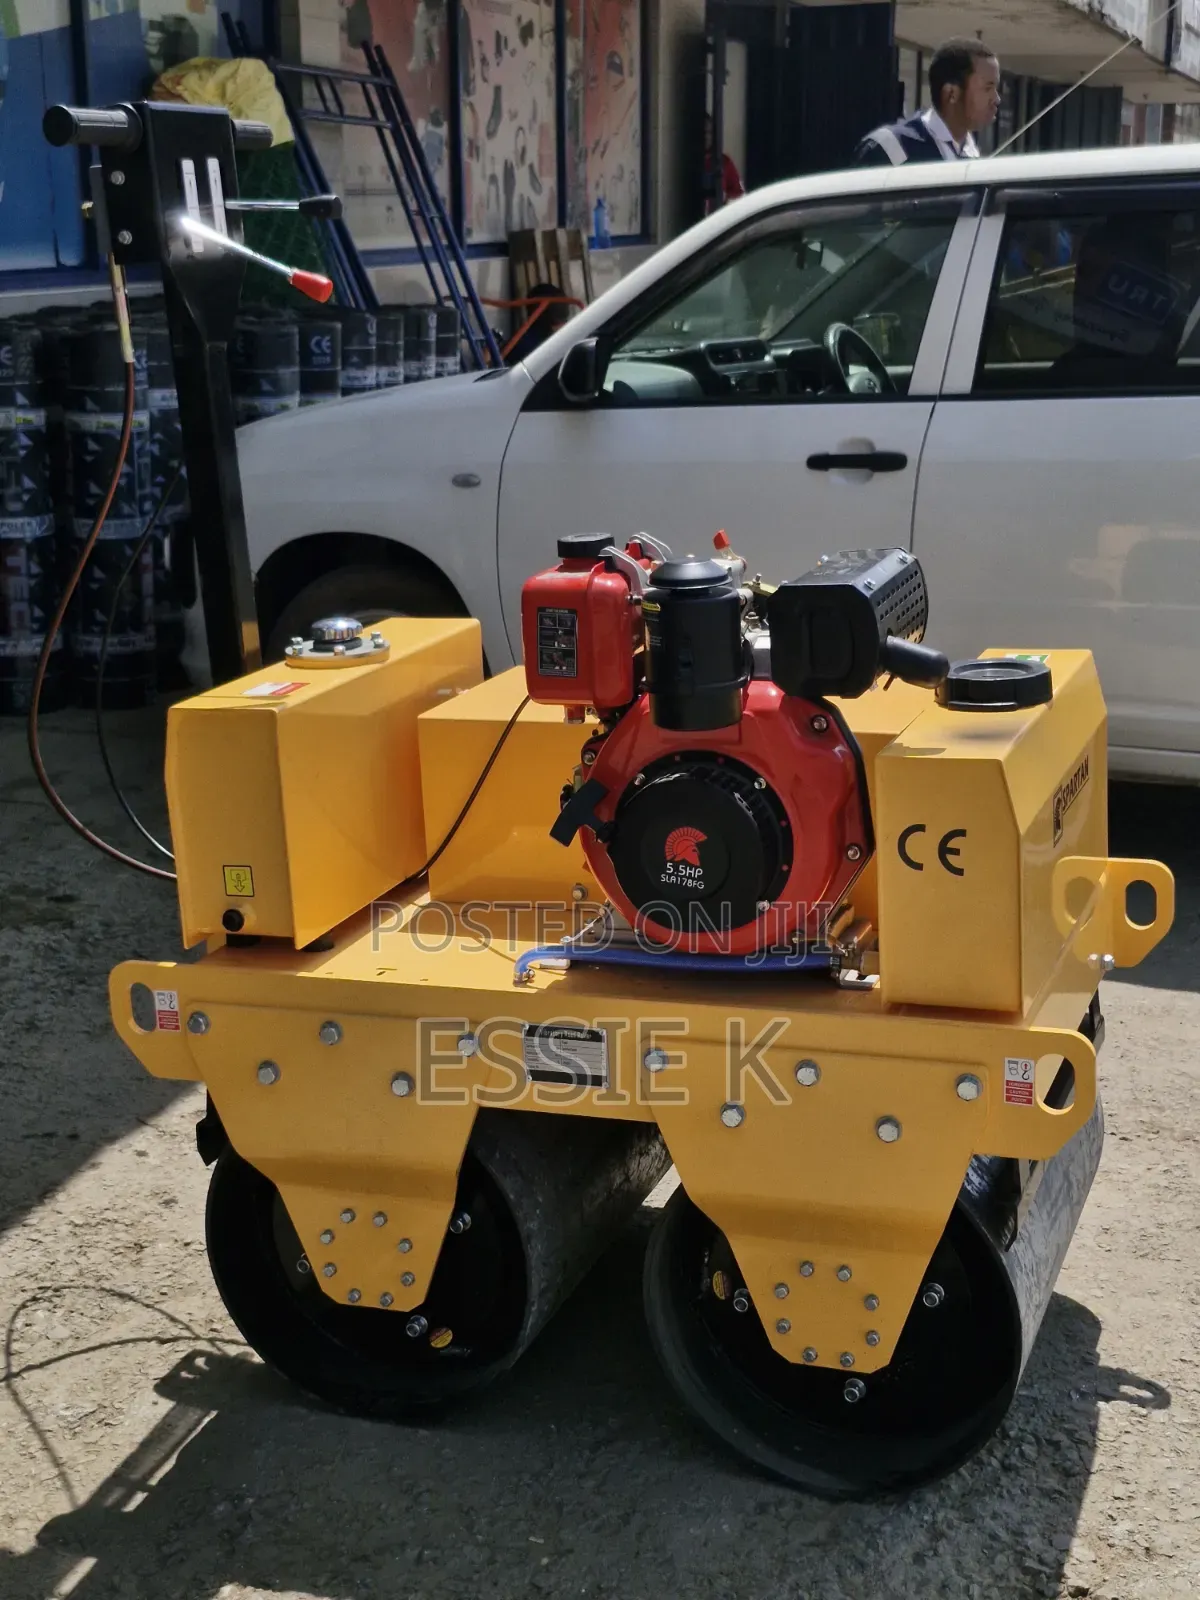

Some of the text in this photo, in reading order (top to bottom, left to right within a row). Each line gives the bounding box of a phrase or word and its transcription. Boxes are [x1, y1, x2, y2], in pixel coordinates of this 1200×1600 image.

[1062, 754, 1089, 813] SPARTAN
[898, 824, 967, 876] CE
[660, 874, 705, 889] SLA178FG
[666, 862, 703, 878] 5.5HP
